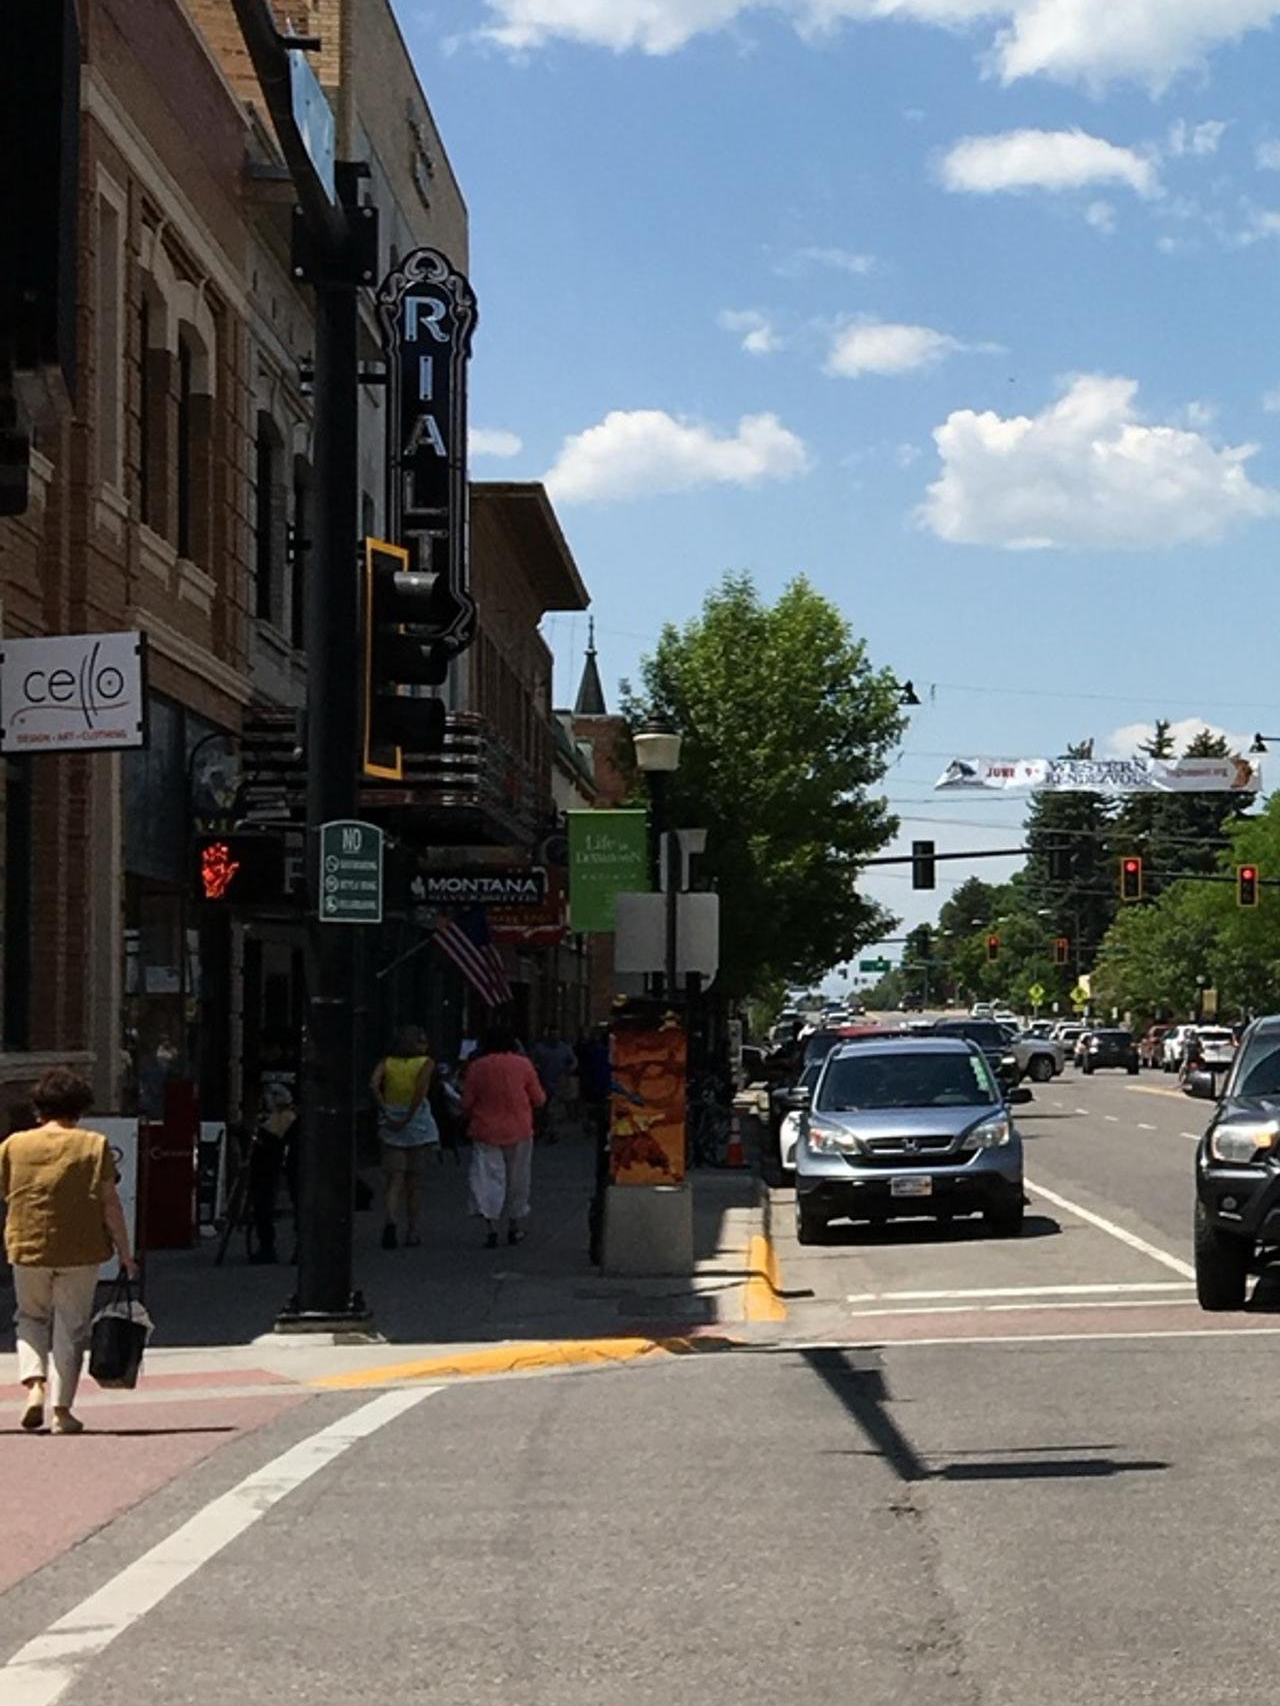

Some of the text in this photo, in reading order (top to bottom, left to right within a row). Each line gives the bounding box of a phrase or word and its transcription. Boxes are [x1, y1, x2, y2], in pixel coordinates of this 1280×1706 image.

[401, 295, 451, 573] RIALT
[23, 640, 124, 730] cello
[985, 767, 1015, 779] JUNE
[1048, 759, 1148, 774] WESTERN
[342, 827, 362, 851] NO
[427, 877, 538, 893] MONTANA
